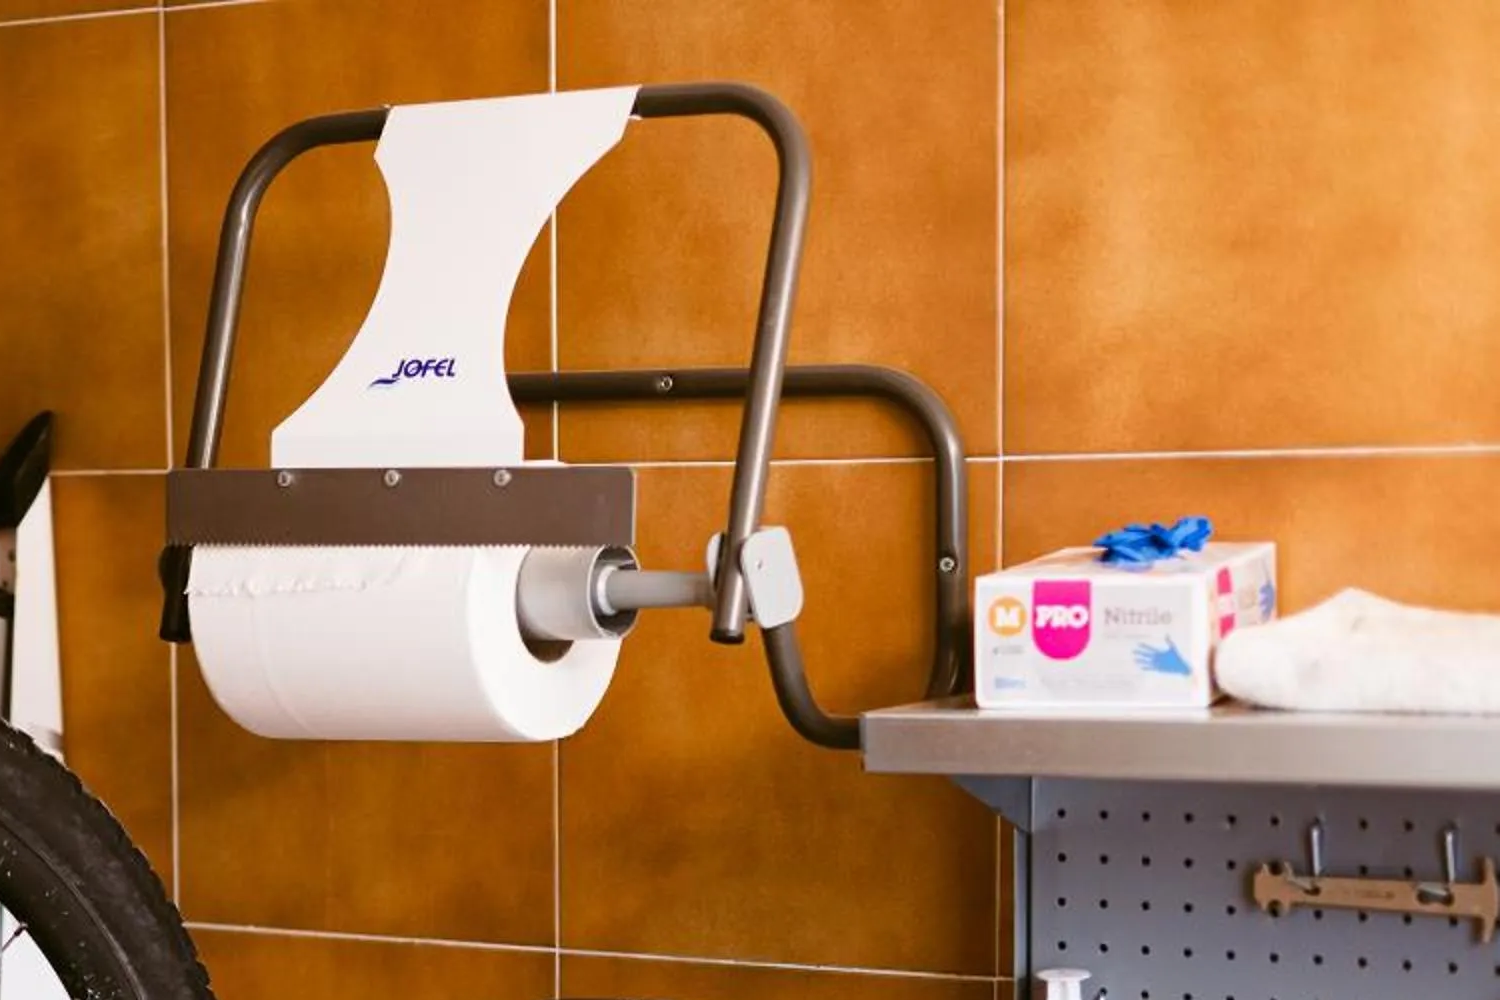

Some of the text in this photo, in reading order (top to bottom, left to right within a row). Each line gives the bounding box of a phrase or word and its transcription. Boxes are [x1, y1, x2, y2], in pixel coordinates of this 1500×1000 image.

[994, 605, 1021, 628] M
[1034, 604, 1090, 629] PRO
[1103, 605, 1173, 626] Nitrile
